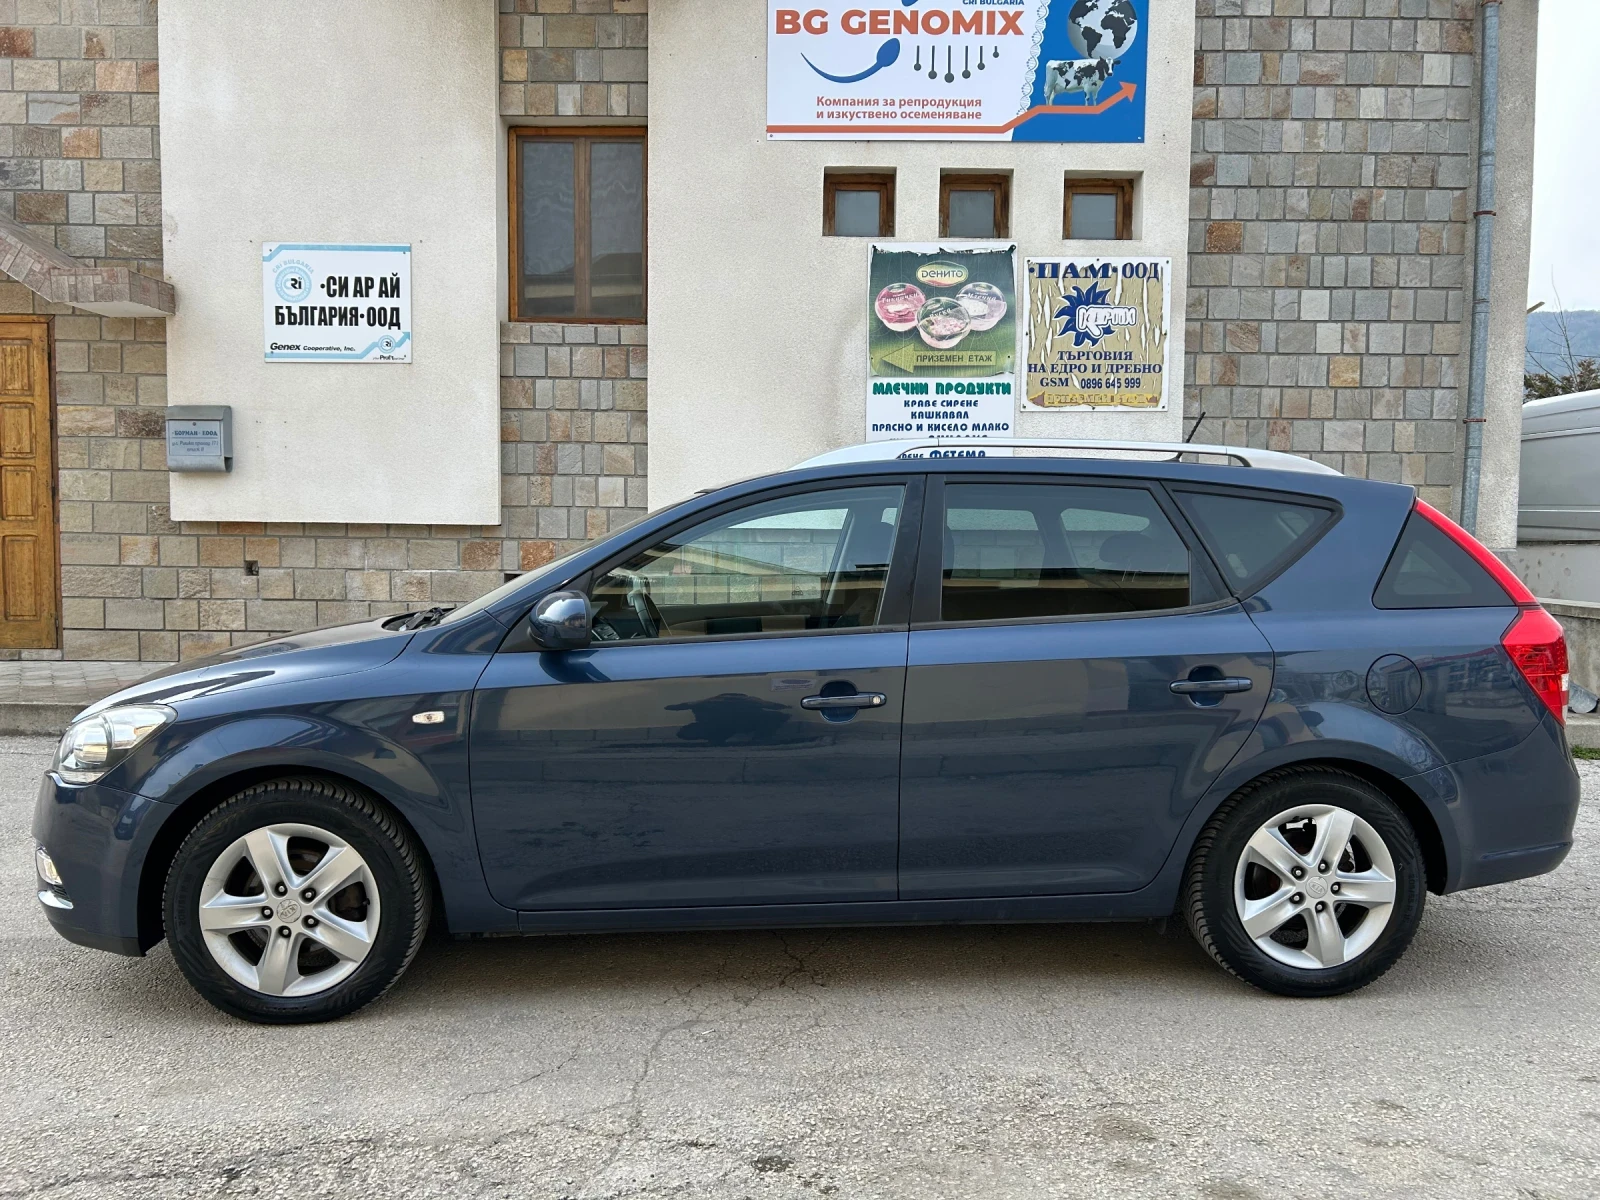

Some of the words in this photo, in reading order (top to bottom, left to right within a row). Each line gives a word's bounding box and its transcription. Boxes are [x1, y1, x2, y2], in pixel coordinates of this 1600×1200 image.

[775, 9, 829, 35] BG
[840, 9, 1025, 35] GENOMIX
[816, 96, 880, 107] Компания
[882, 98, 896, 107] за
[899, 98, 982, 109] репродукция
[816, 110, 824, 119] и
[827, 110, 898, 121] изкуствено
[900, 111, 982, 120] осеменяване
[1121, 262, 1160, 282] ООД
[352, 276, 375, 298] АР
[378, 272, 401, 298] АЙ
[270, 342, 302, 351] Genex
[916, 354, 964, 362] ПРИЗЕМЕН
[968, 354, 993, 362] ЕТАЖ
[1057, 350, 1134, 361] ТЪРГОВИЯ
[1027, 363, 1046, 374] НА
[1049, 363, 1088, 375] ЕДРО
[1091, 363, 1102, 373] И
[1104, 363, 1163, 374] ДРЕБНО
[872, 382, 929, 395] МЛЕЧНИ
[935, 382, 1012, 395] ПРОДУКТИ
[1040, 377, 1069, 388] GSM
[1080, 378, 1103, 389] 0896
[1105, 378, 1122, 389] 645
[1124, 377, 1141, 389] 999
[903, 400, 938, 408] КРАВЕ
[940, 400, 979, 408] СИРЕНЕ
[910, 411, 970, 419] КАШКАВАЛ
[872, 423, 913, 432] ПРЯСНО
[916, 423, 923, 431] И
[927, 423, 968, 431] КИСЕЛО
[972, 422, 1010, 431] МЛЯКО
